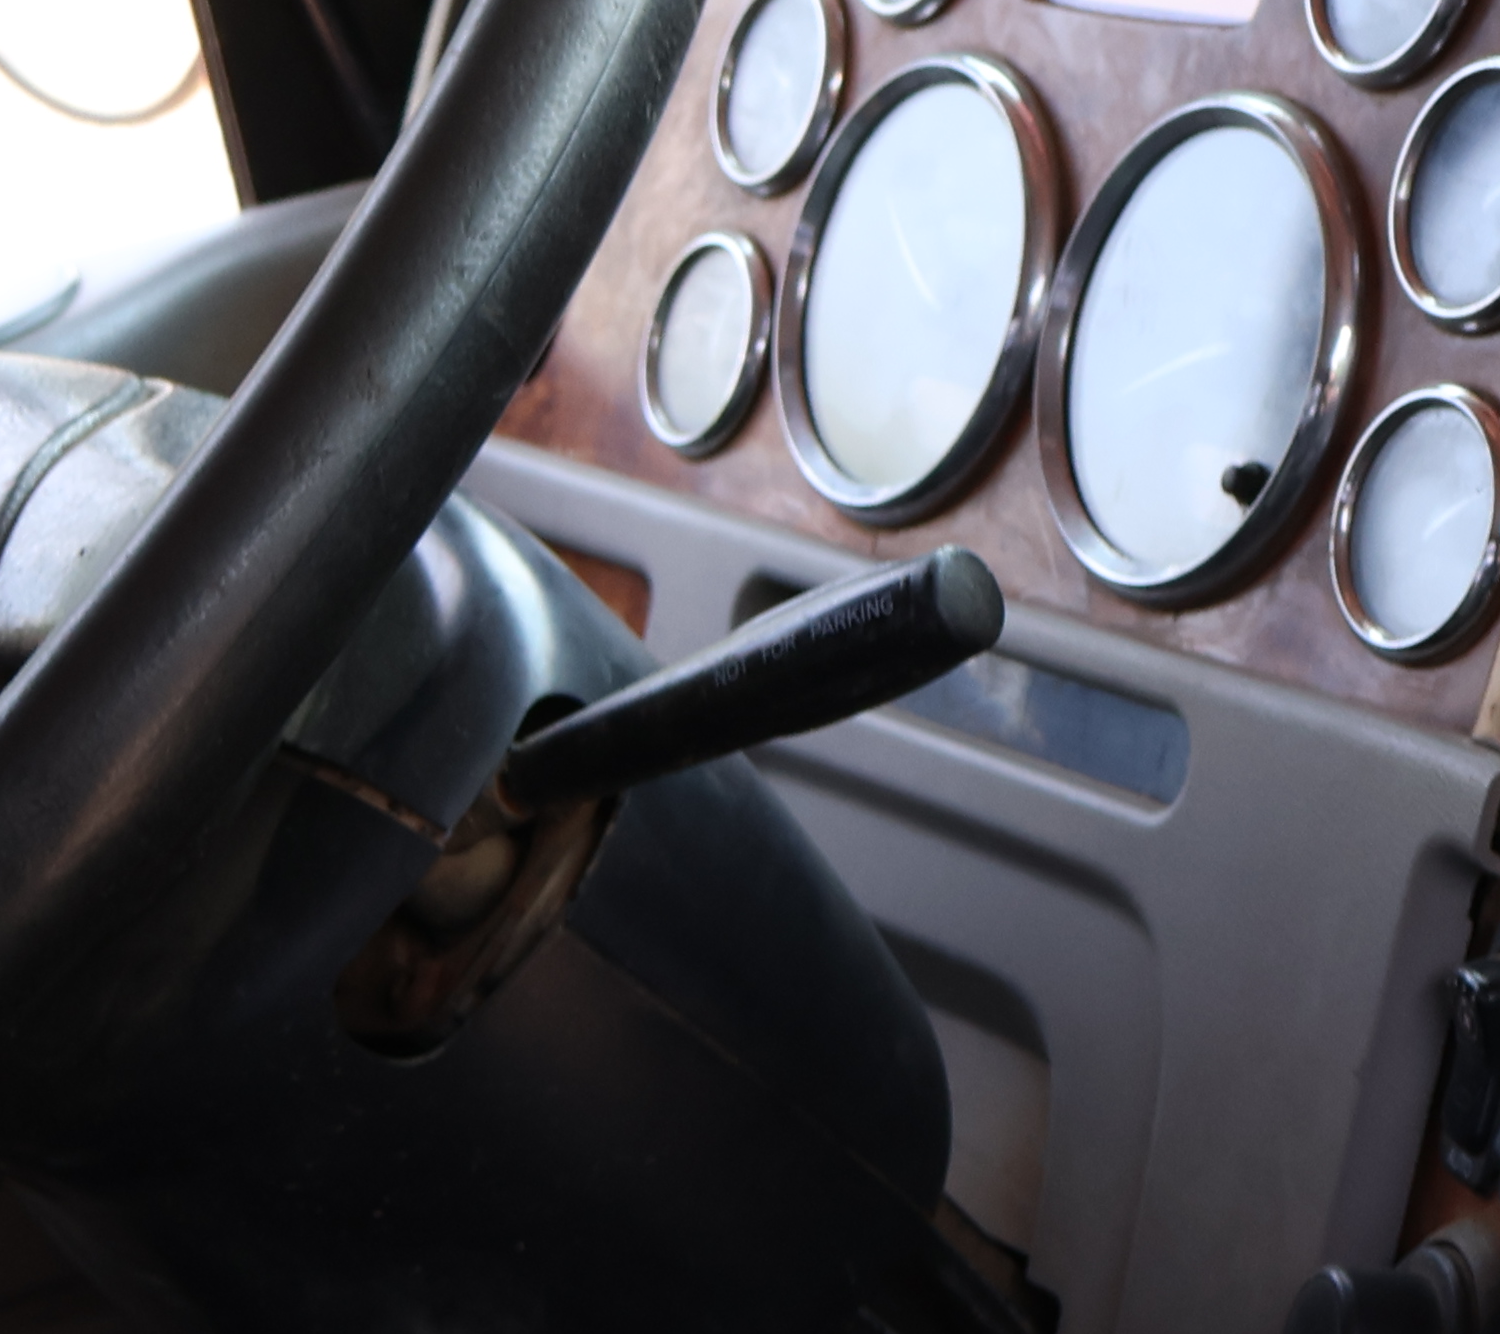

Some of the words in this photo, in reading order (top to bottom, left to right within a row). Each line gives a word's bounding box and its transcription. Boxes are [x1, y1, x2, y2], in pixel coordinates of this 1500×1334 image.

[713, 652, 749, 687] NOT
[761, 633, 797, 663] FOR
[809, 591, 894, 641] PARKING
